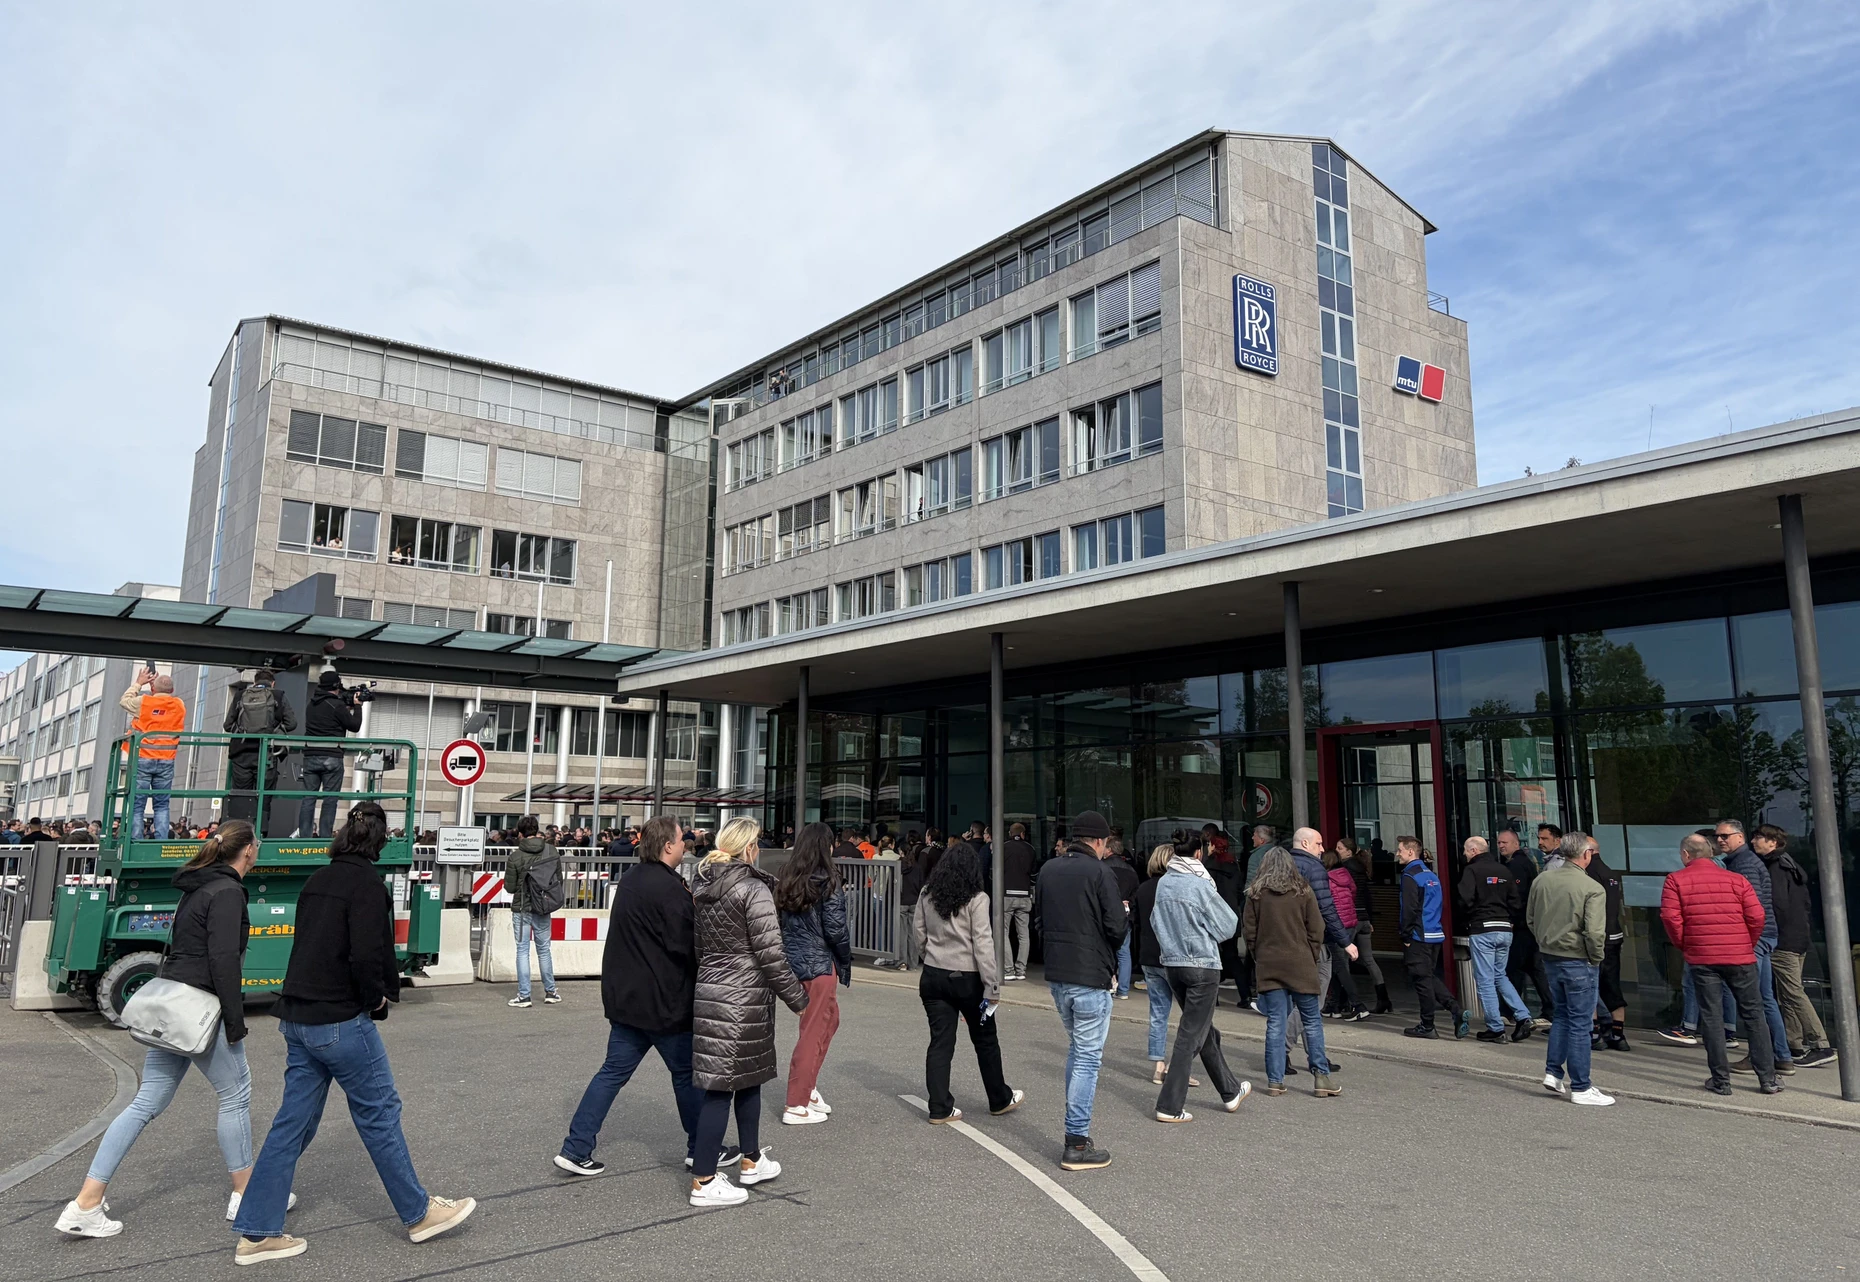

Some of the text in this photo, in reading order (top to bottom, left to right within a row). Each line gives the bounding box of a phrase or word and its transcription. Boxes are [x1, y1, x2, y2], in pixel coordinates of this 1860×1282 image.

[1241, 279, 1272, 297] ROLLS
[1243, 297, 1272, 353] RR
[1243, 352, 1275, 371] ROYCE
[1397, 376, 1418, 389] mtu
[278, 847, 329, 855] www.graeb
